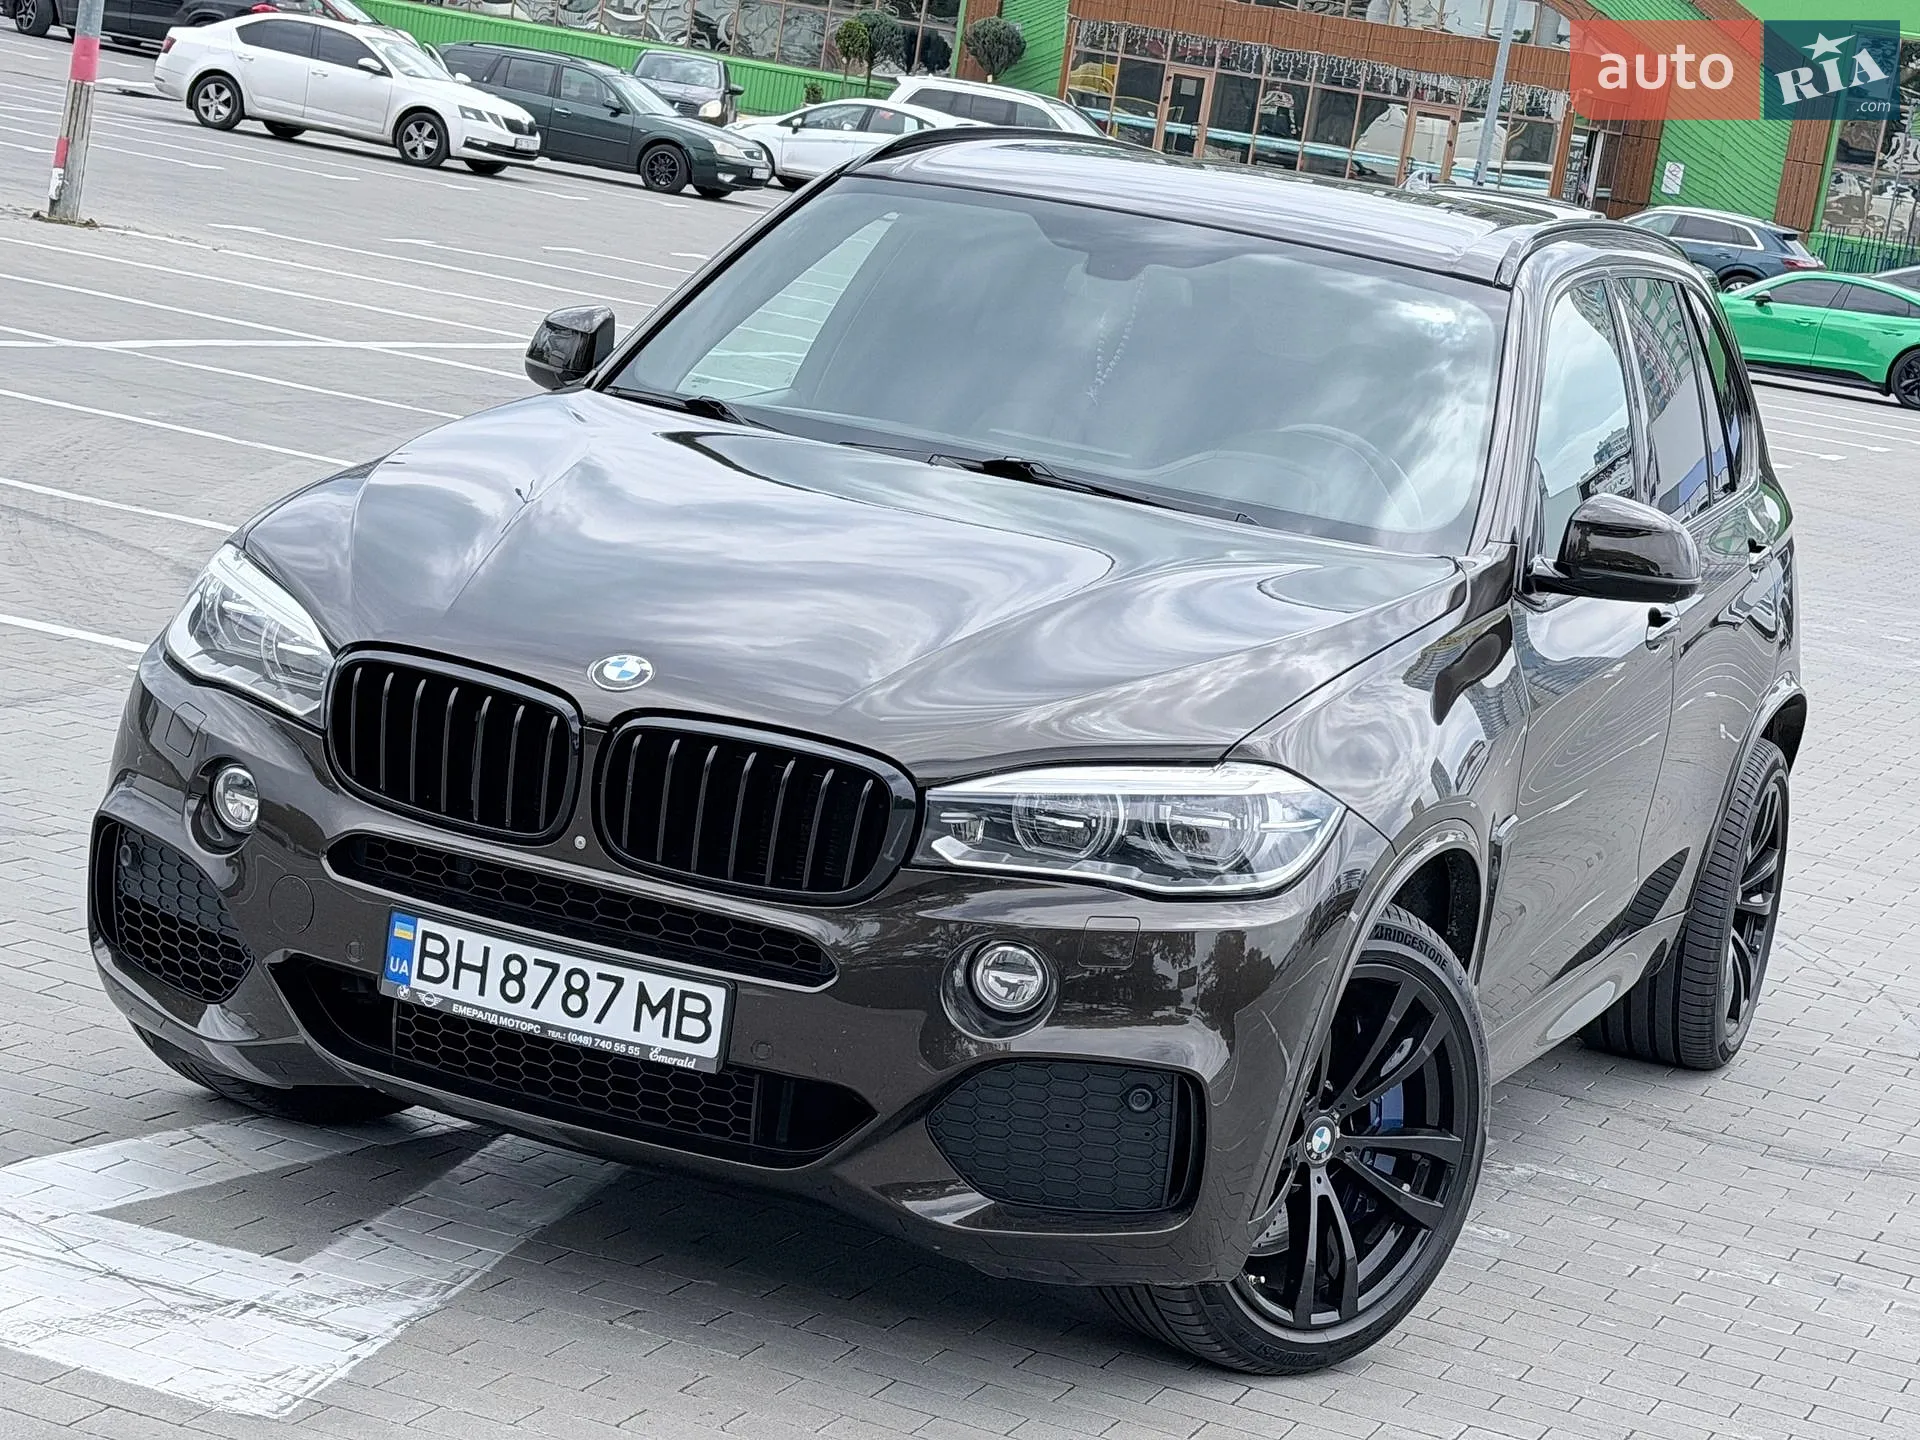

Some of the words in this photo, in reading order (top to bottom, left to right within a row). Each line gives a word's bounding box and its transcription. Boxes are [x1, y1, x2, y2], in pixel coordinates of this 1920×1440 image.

[389, 956, 409, 977] UA
[499, 953, 626, 1025] 8787
[452, 1003, 498, 1026] ЕМЕРАЛД
[499, 1016, 541, 1034] МОТОРС
[567, 1031, 593, 1047] (048)
[593, 1037, 612, 1051] 740
[613, 1042, 626, 1053] 55
[627, 1045, 640, 1056] 55
[648, 1046, 697, 1069] Emerald
